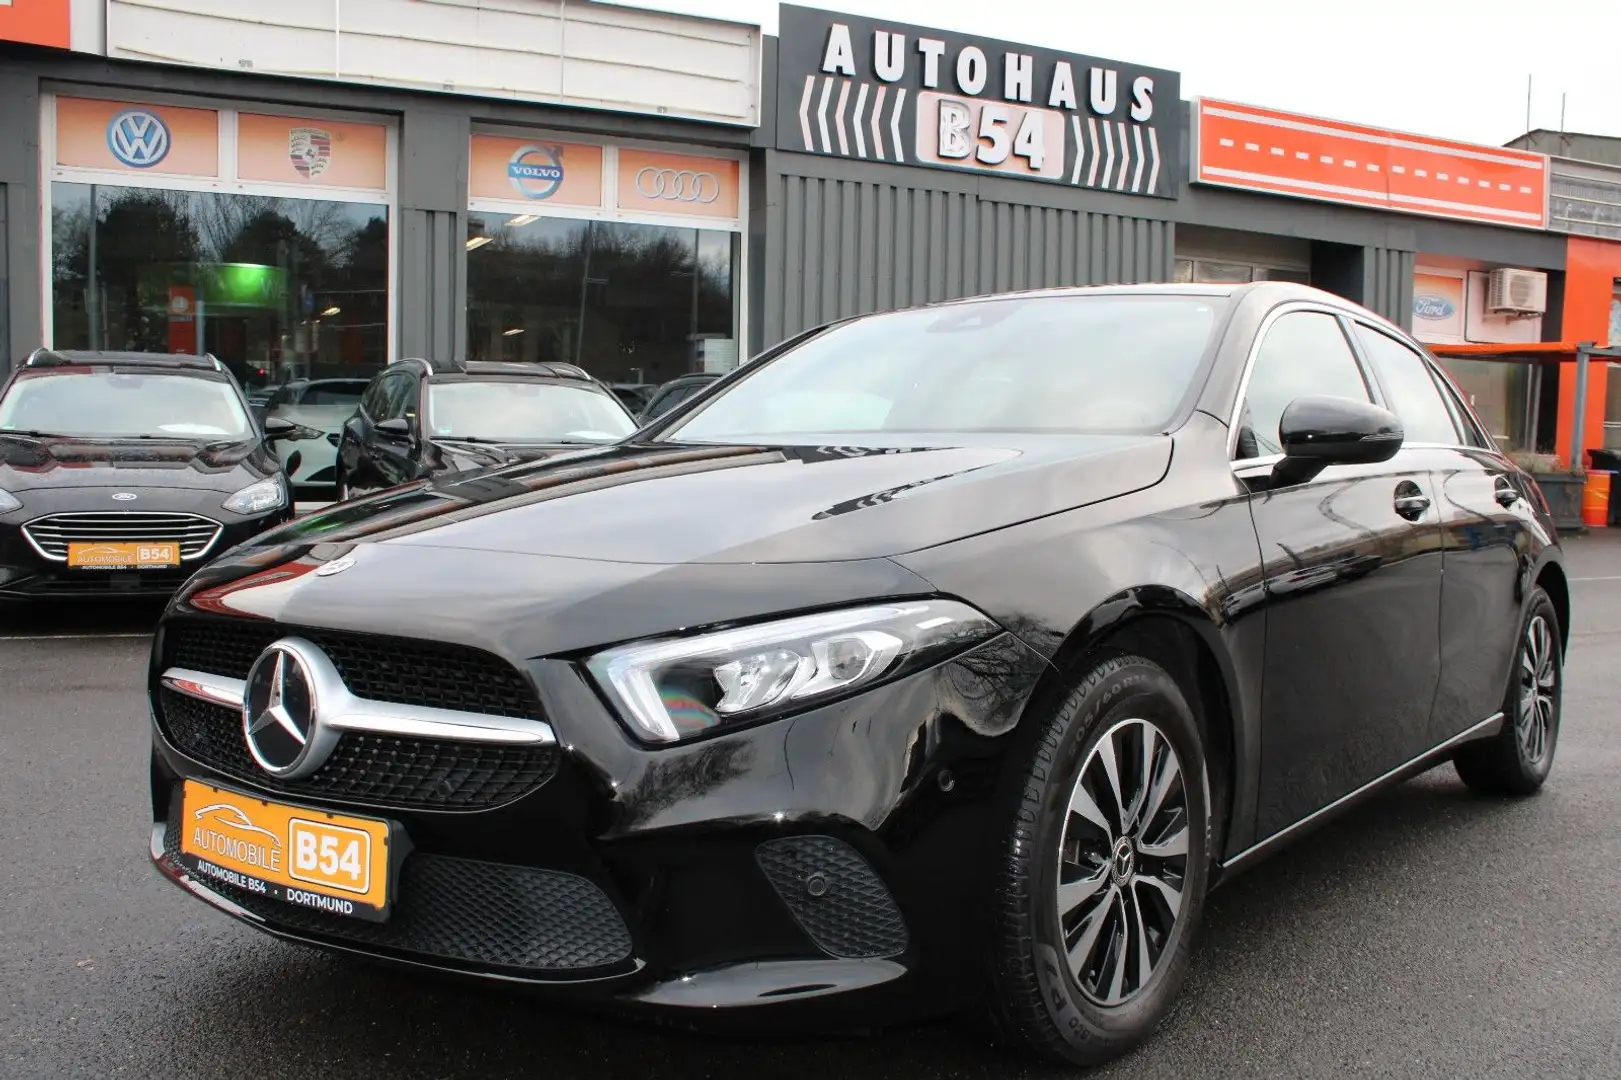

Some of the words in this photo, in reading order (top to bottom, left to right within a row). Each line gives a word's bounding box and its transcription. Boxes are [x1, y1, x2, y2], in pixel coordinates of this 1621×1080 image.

[821, 22, 1154, 122] AUTOHAUS
[937, 98, 1045, 170] B54
[511, 166, 560, 178] VOLVO
[77, 555, 133, 563] AUTOMOBILE
[140, 548, 170, 560] B54
[193, 826, 281, 873] AUTOMOBILE
[297, 830, 361, 881] B54
[197, 859, 247, 888] AUTOMOBILE
[248, 877, 267, 894] B54
[287, 888, 353, 914] DORTMUND
